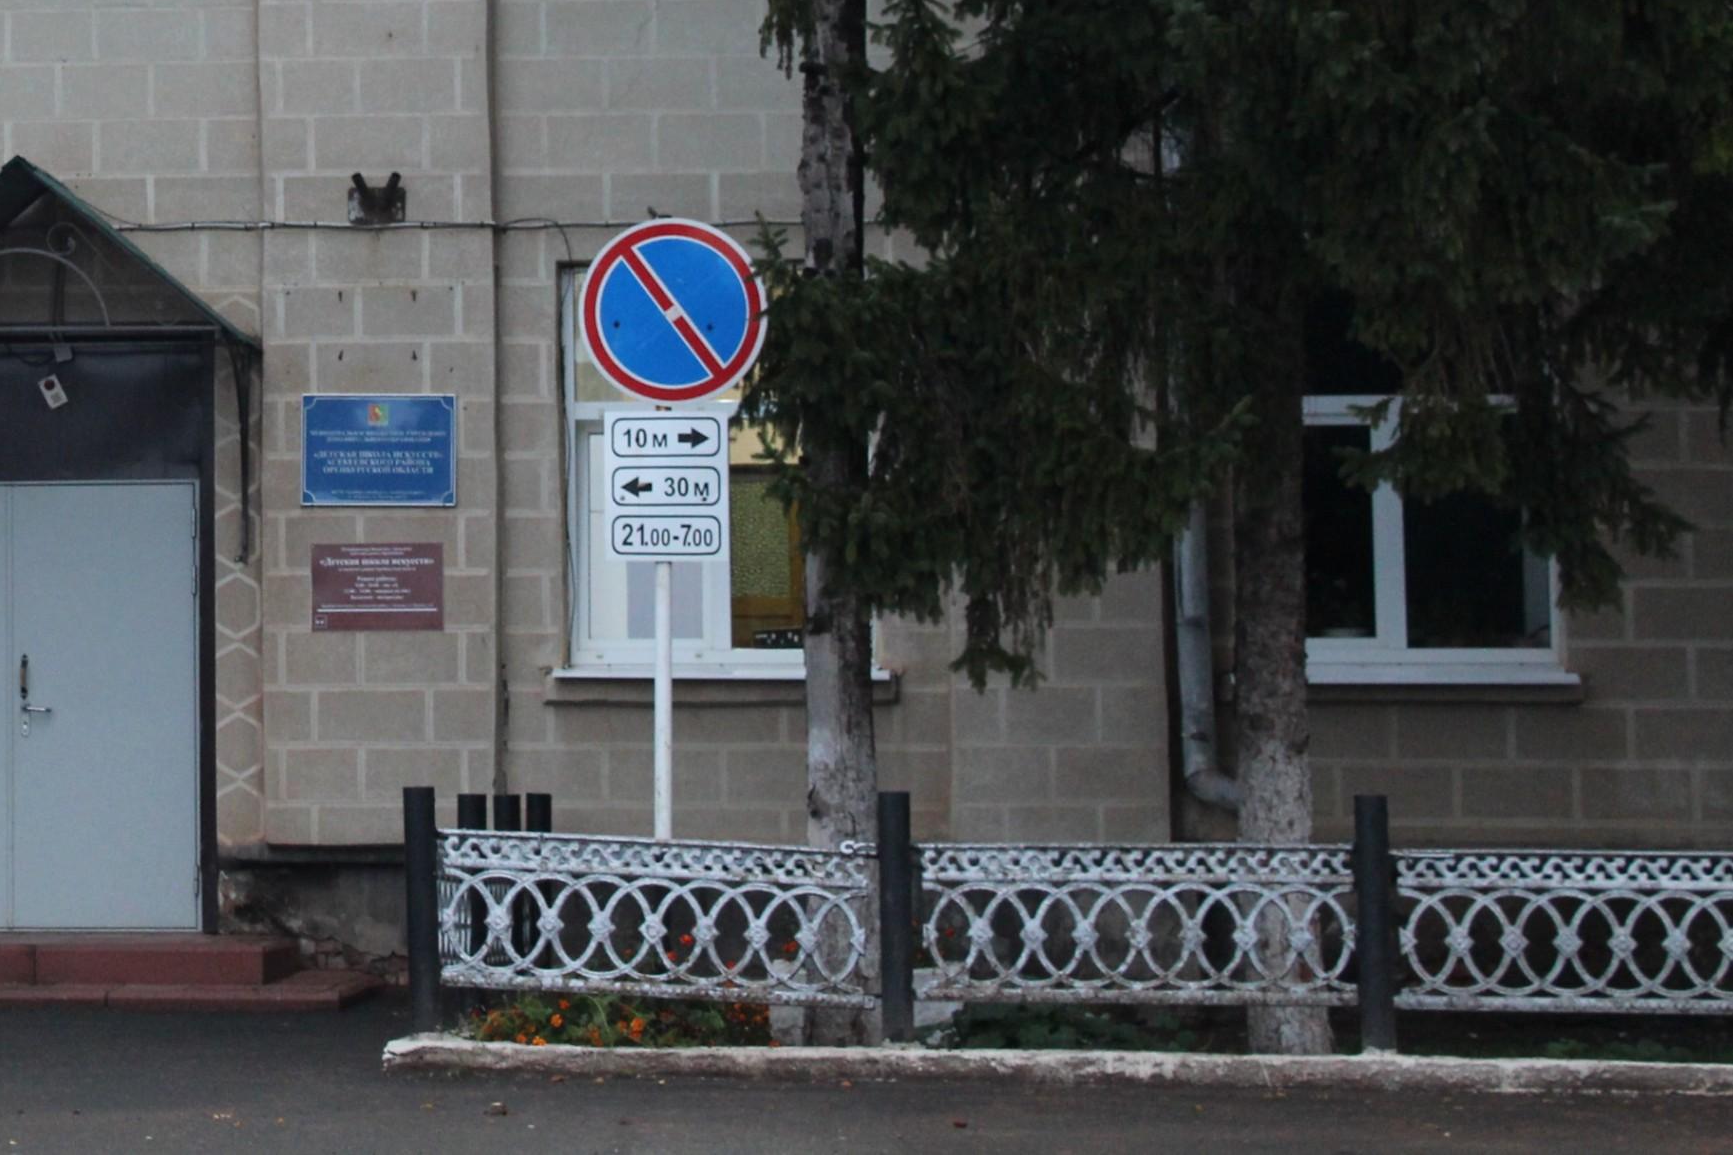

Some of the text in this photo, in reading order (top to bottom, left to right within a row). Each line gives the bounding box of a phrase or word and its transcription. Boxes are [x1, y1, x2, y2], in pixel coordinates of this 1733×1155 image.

[623, 428, 647, 448] 10
[664, 477, 688, 497] 30
[622, 523, 714, 547] 21.00-7.00
